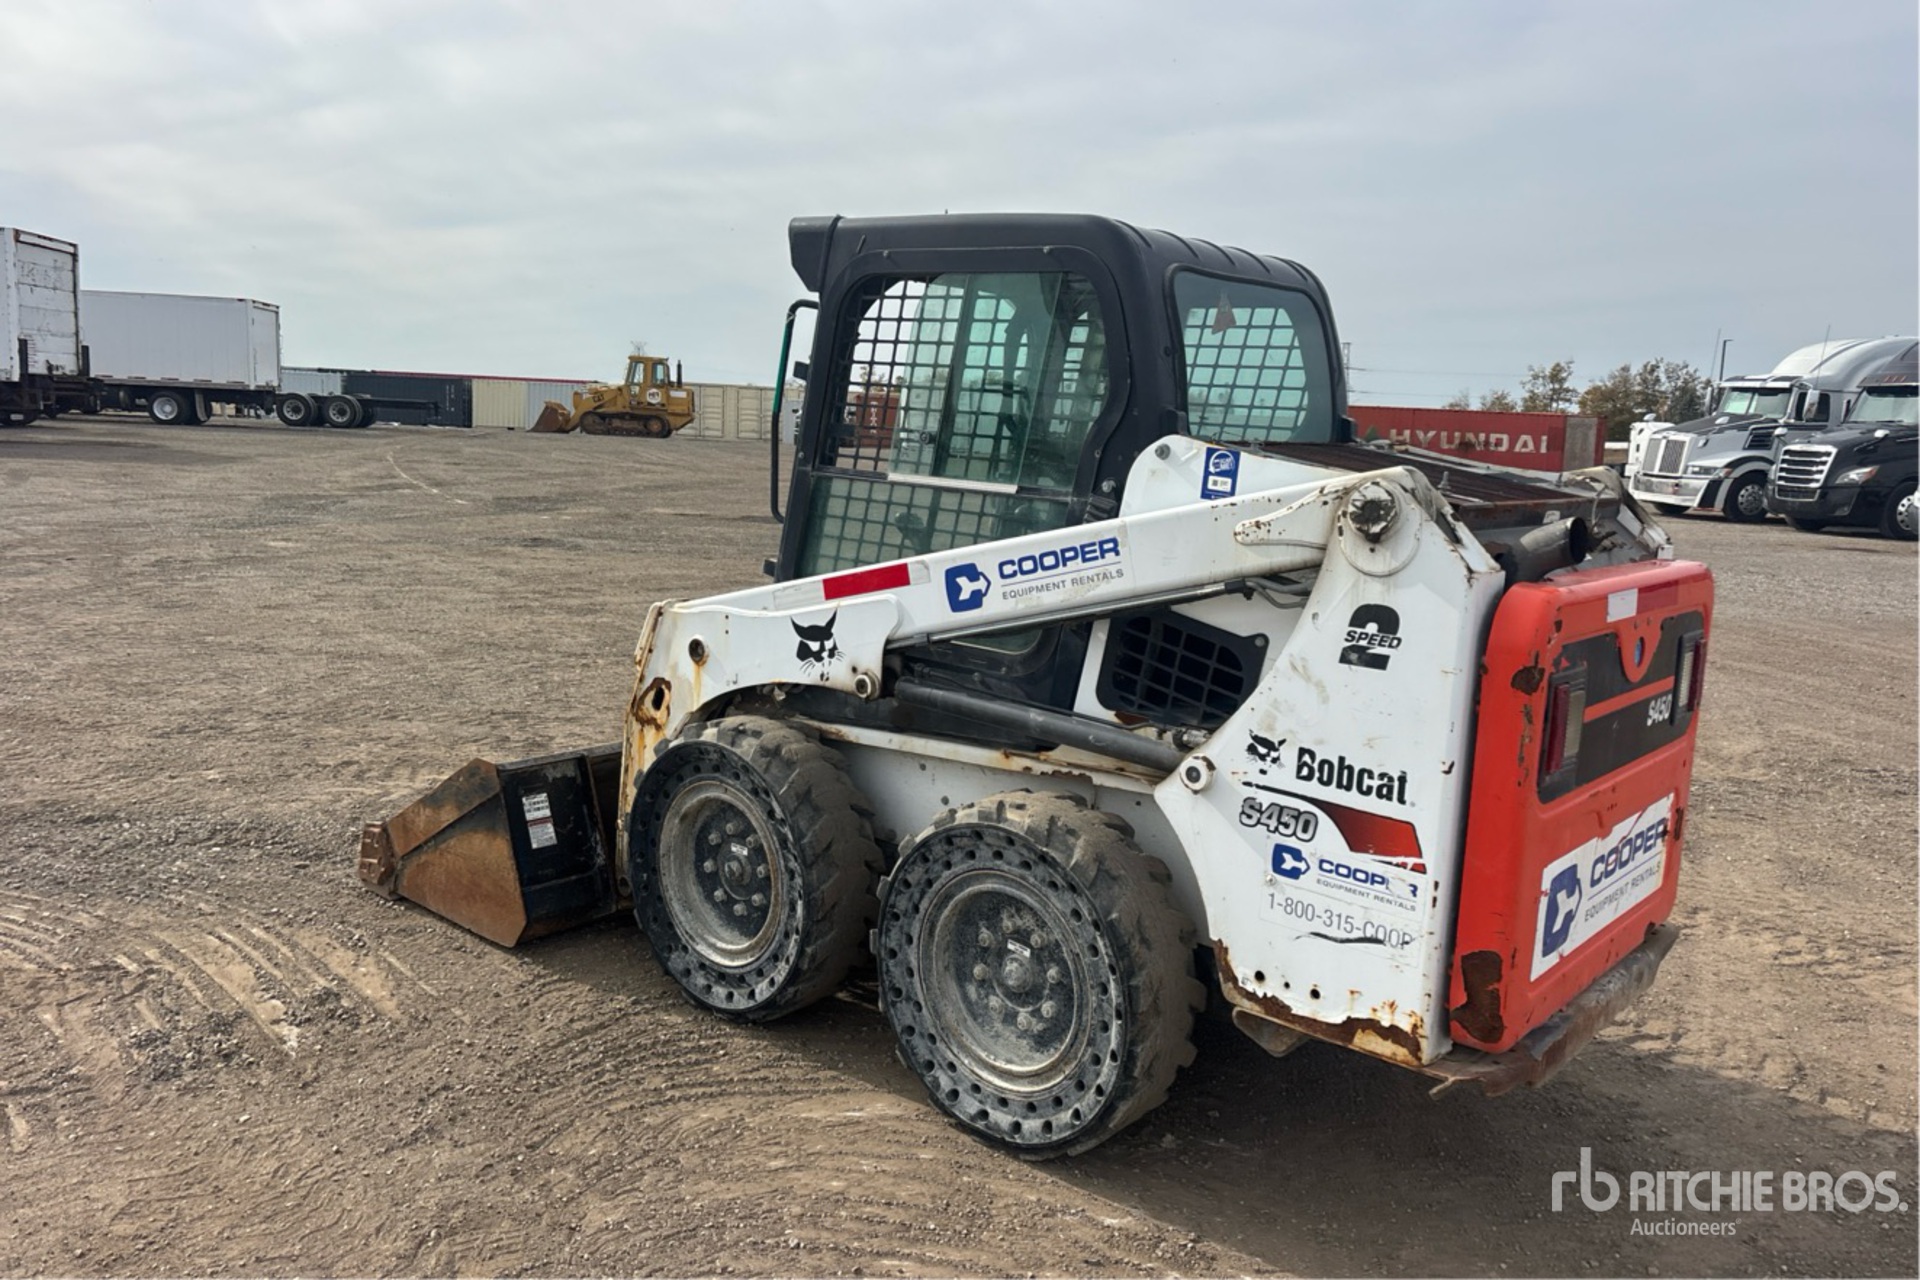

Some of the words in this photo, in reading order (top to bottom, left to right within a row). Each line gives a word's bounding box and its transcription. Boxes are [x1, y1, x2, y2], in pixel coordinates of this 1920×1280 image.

[1389, 428, 1548, 454] HYUNDAI
[998, 537, 1121, 580] COOPER
[1001, 579, 1067, 600] EQUIPMENT
[1071, 568, 1125, 587] RENTALS
[1338, 603, 1401, 671] 2
[1344, 629, 1403, 650] SPEED
[1646, 693, 1673, 727] S450
[1295, 746, 1409, 806] Bobcat
[1239, 796, 1319, 843] S450
[1589, 816, 1668, 889] COOPER
[1316, 878, 1371, 899] EQUIPMENT
[1373, 894, 1417, 912] RENTALS
[1318, 858, 1419, 898] COOPR
[1267, 891, 1414, 950] 1-800-315-COOP
